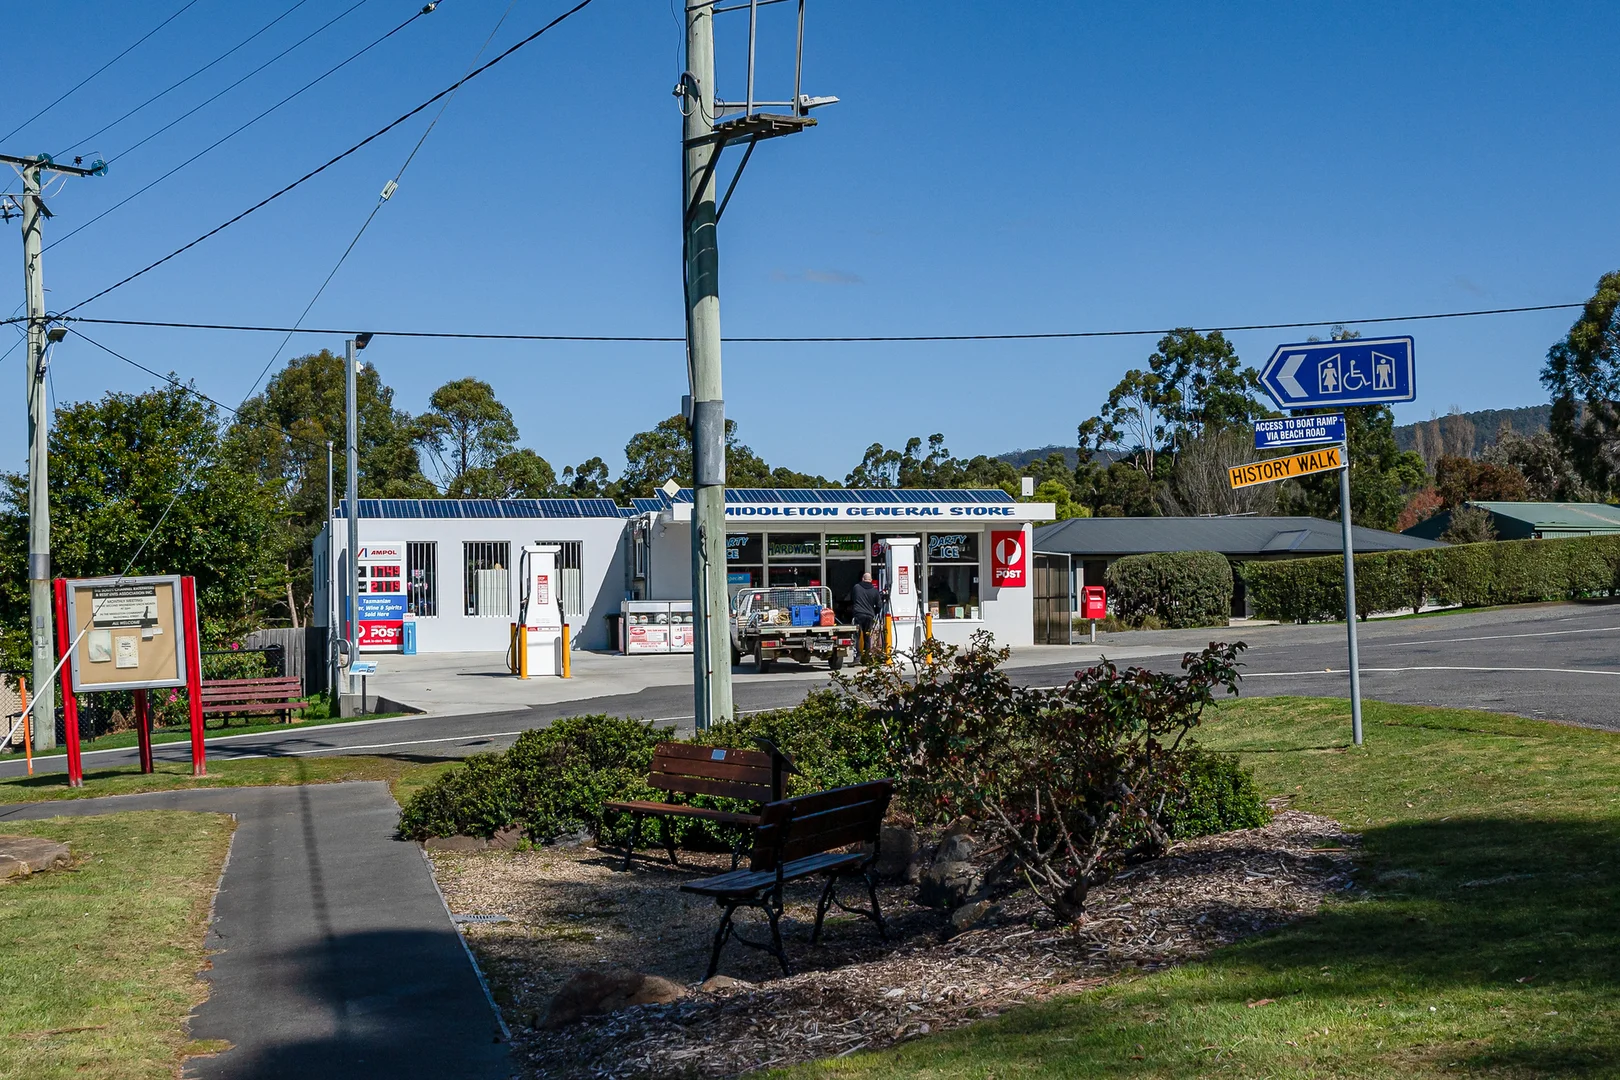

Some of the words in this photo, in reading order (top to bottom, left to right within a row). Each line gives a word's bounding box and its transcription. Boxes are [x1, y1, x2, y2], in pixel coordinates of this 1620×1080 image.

[1255, 421, 1283, 432] ACCESS
[1285, 420, 1294, 429] TO
[1296, 418, 1315, 428] BOAT
[1316, 416, 1338, 426] RAMP
[1266, 431, 1279, 440] VIA
[1280, 429, 1304, 440] BEACH
[1305, 427, 1326, 437] ROAD
[1232, 459, 1291, 485] HISTORY
[1296, 450, 1337, 472] WALK
[846, 506, 943, 516] GENERAL
[950, 506, 1015, 516] STORE
[768, 541, 821, 556] HARDWARE
[928, 535, 967, 555] PARTY
[726, 548, 739, 559] CE
[941, 546, 960, 558] ICE
[727, 575, 744, 583] pecial
[996, 570, 1022, 578] POST
[371, 628, 402, 637] POST
